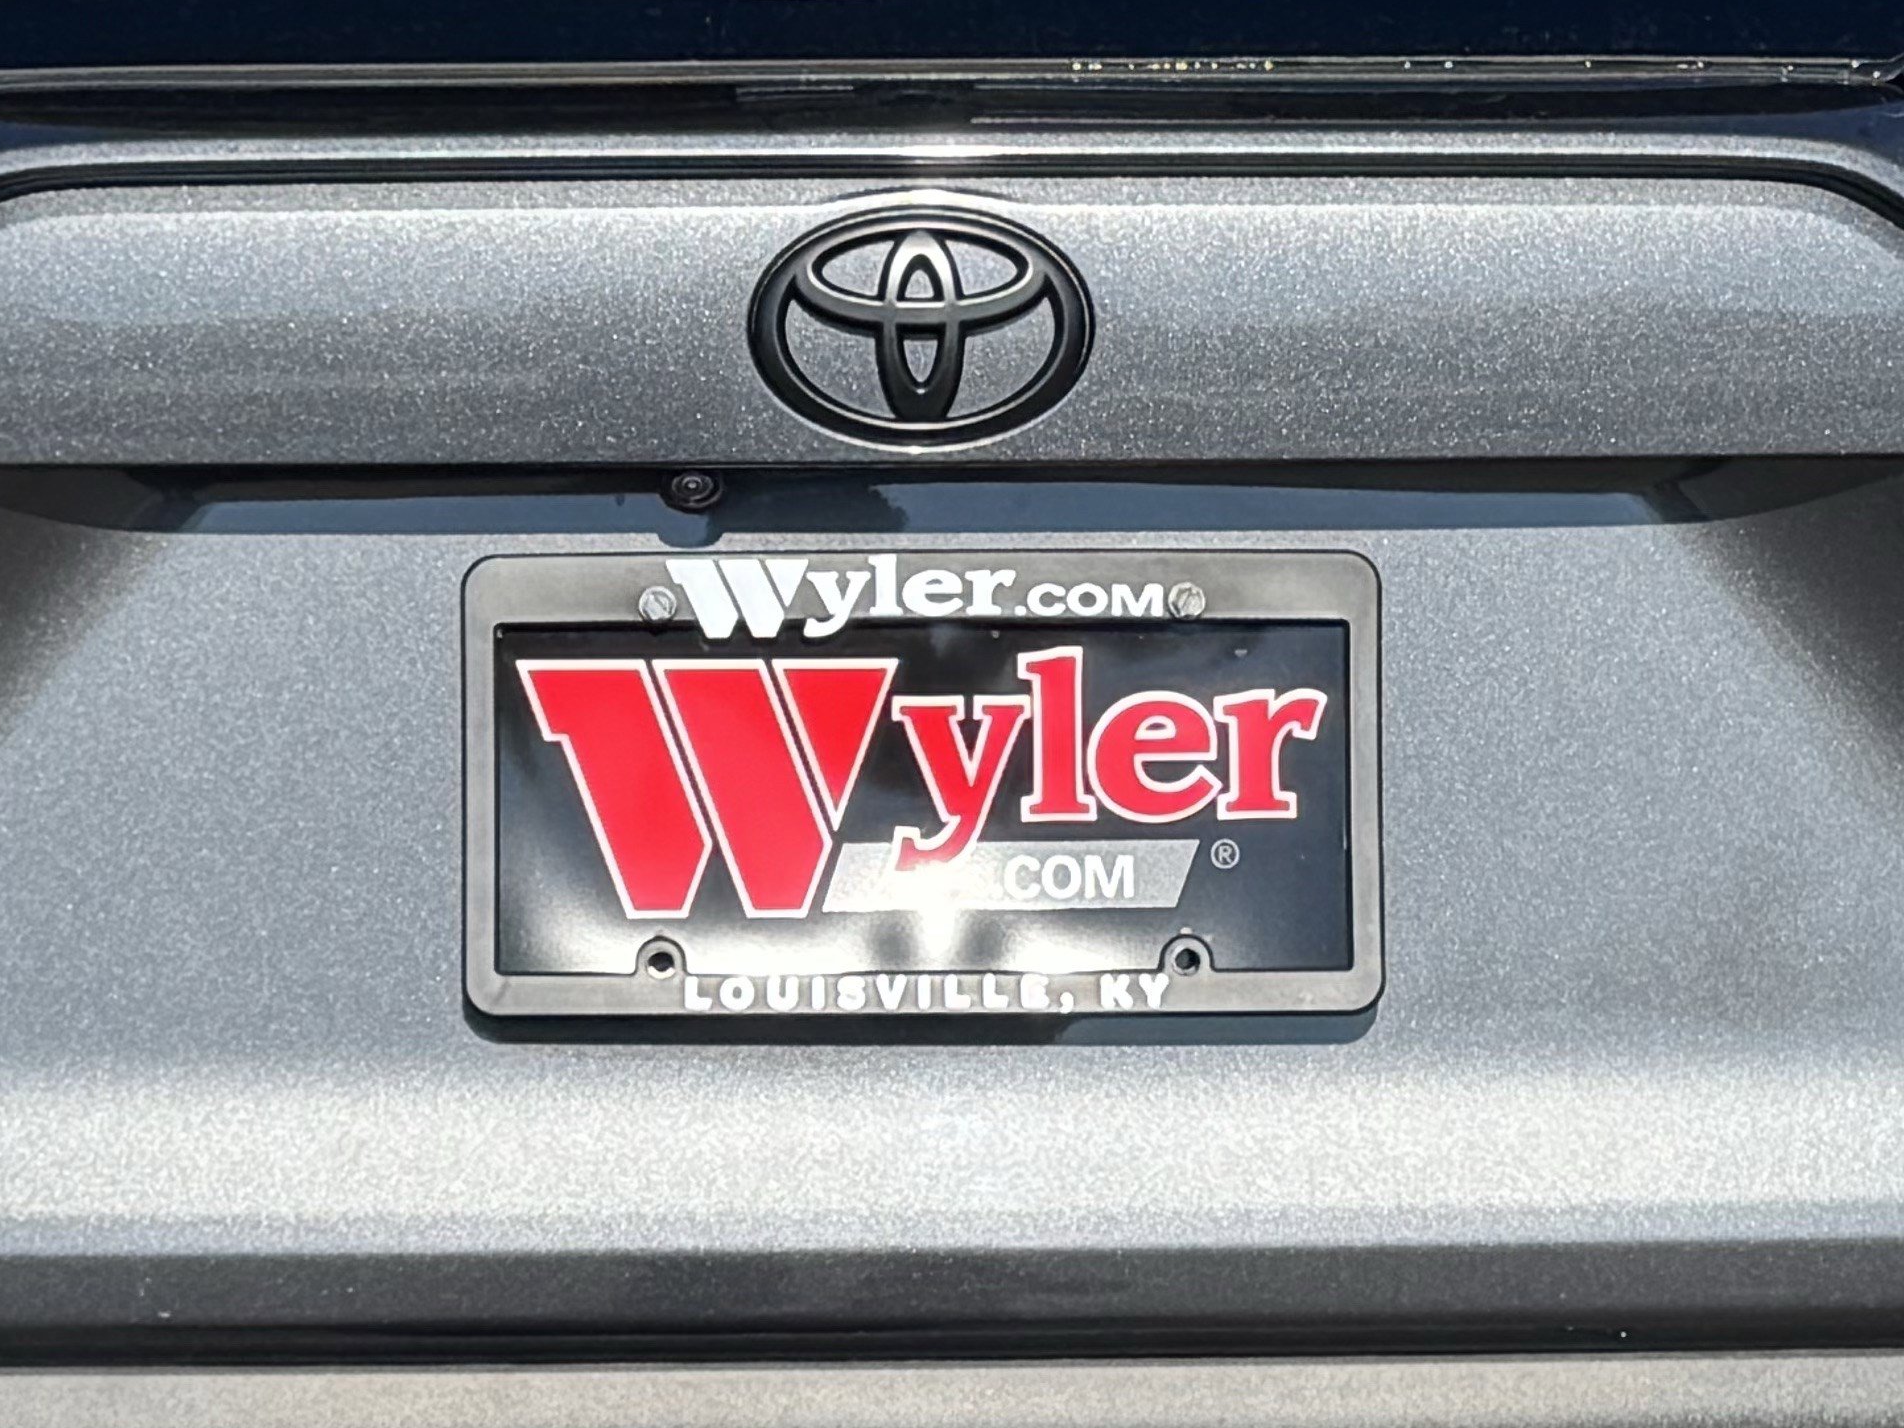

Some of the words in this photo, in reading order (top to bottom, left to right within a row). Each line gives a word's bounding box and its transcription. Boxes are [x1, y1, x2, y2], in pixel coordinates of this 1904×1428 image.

[516, 646, 1328, 918] Wyler
[683, 972, 1075, 1013] LOUISVILLE,
[1100, 972, 1170, 1010] KY
